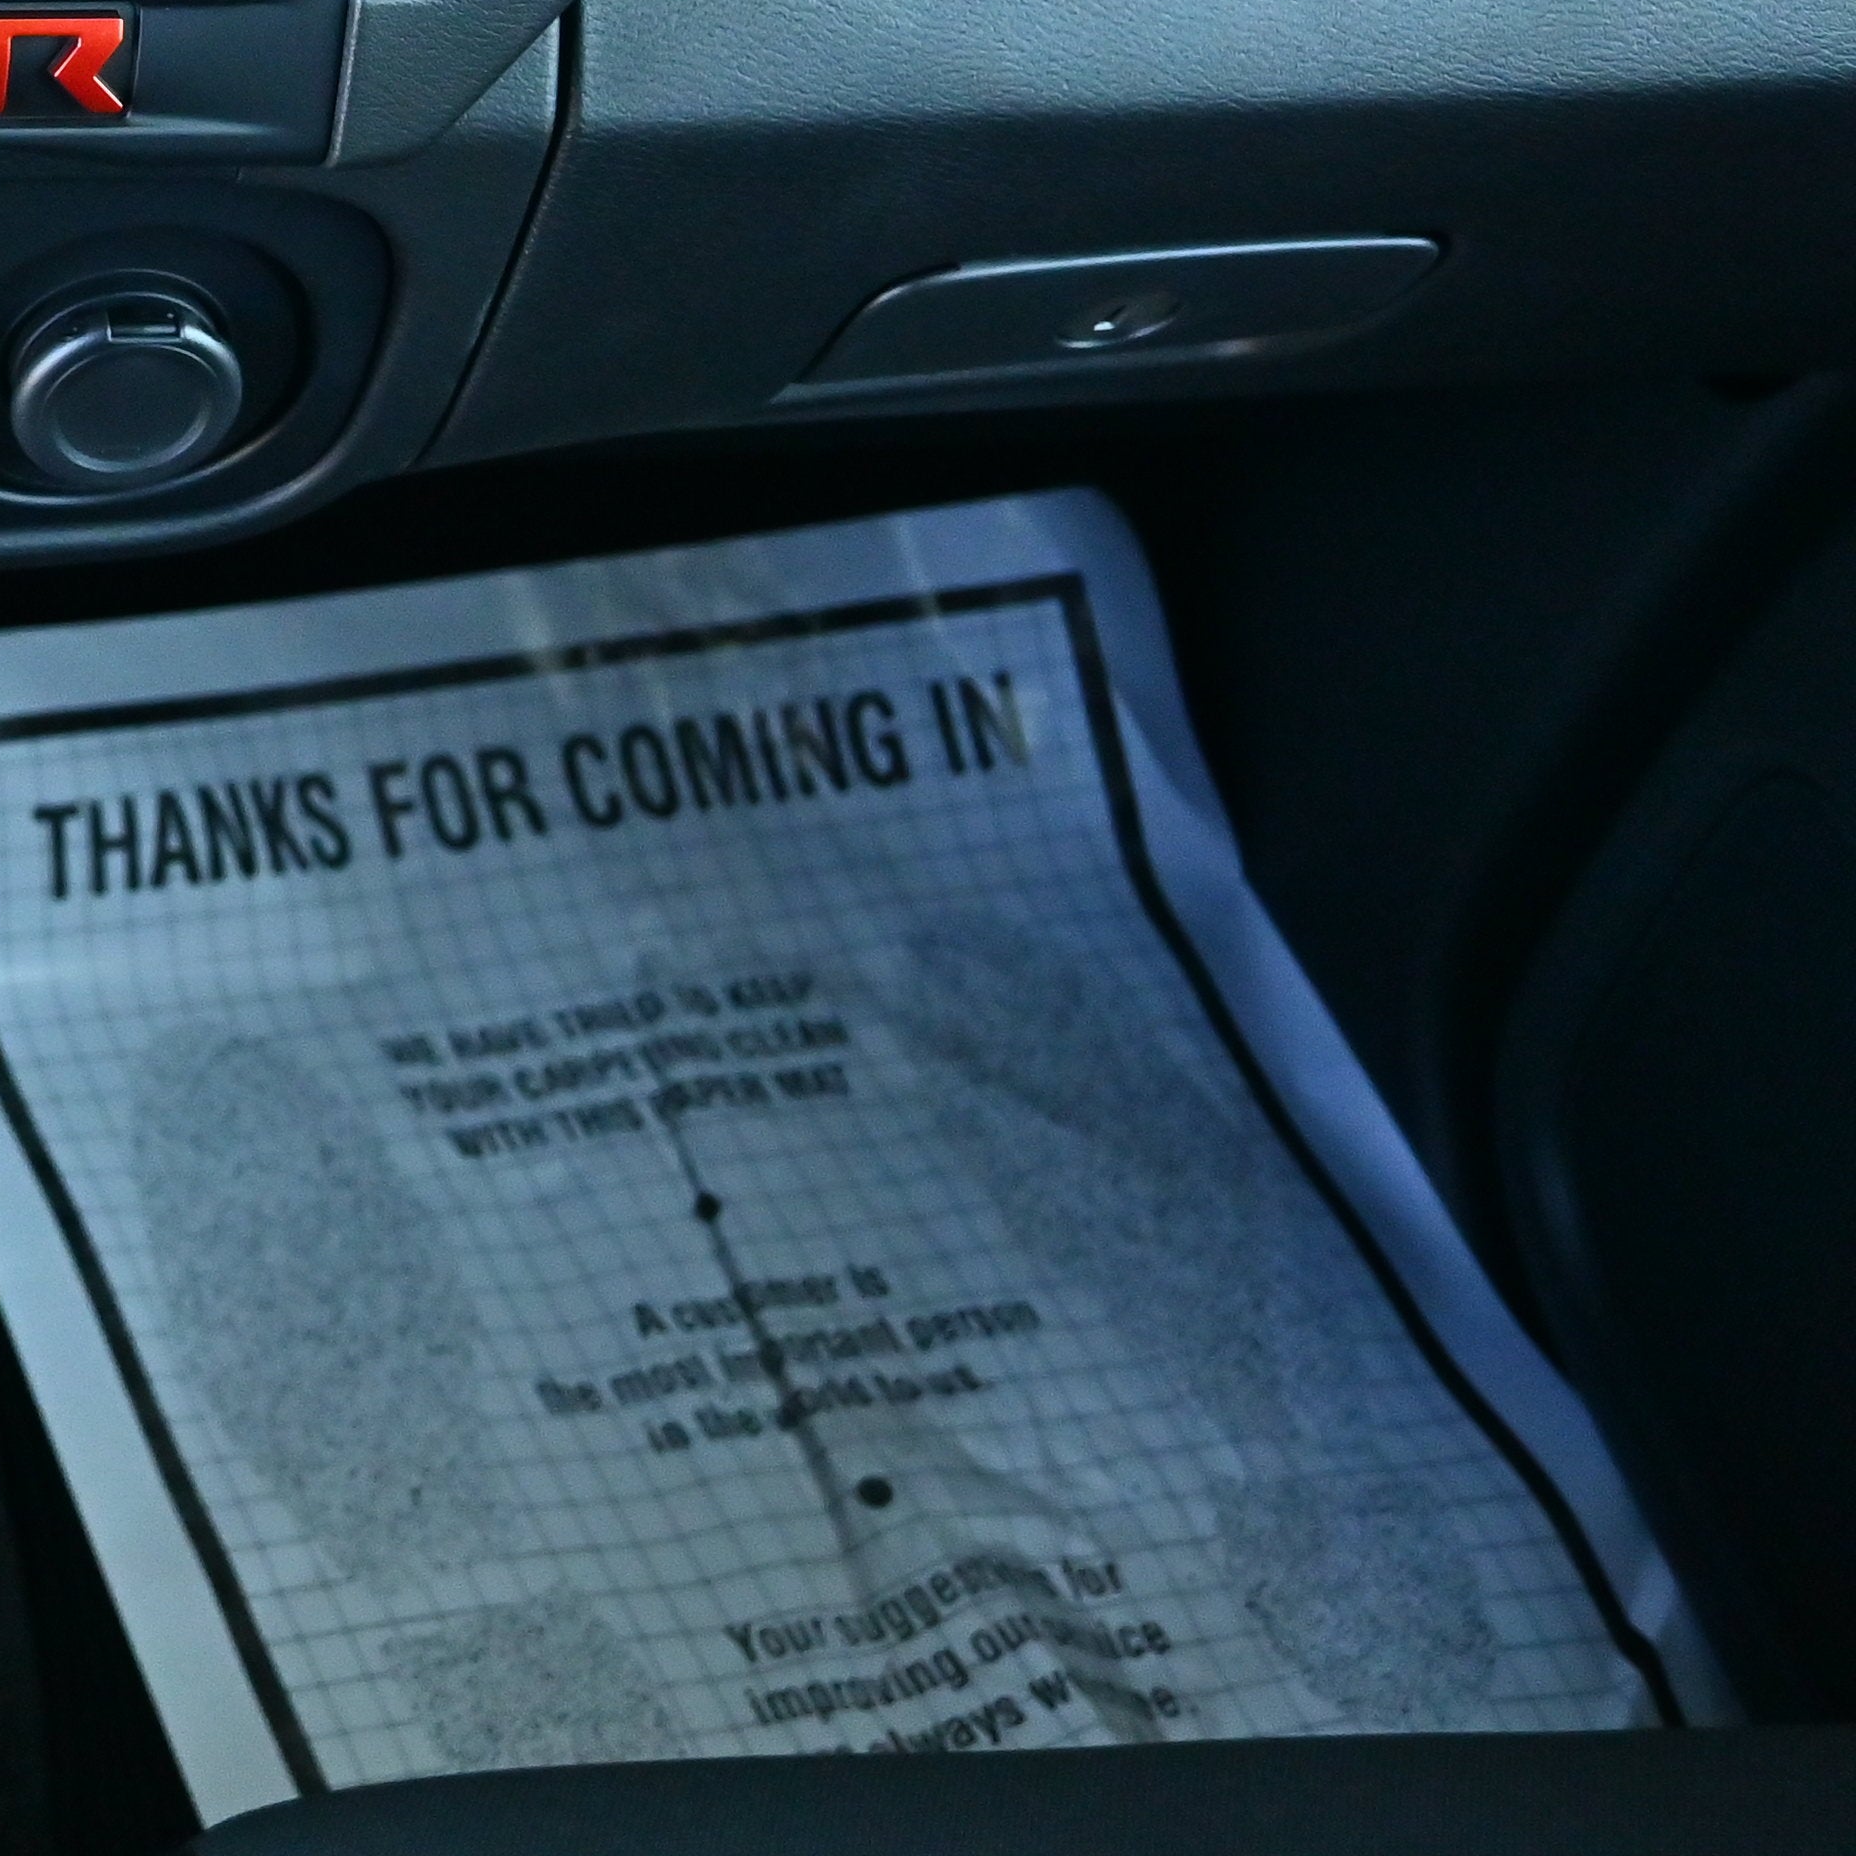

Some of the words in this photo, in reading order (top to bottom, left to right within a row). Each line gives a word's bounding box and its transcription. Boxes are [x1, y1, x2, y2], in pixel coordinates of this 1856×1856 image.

[32, 769, 354, 902] THANKS
[366, 746, 549, 859] FOR
[560, 688, 913, 831] COMING
[928, 669, 1030, 777] IN
[723, 1614, 830, 1665] Your
